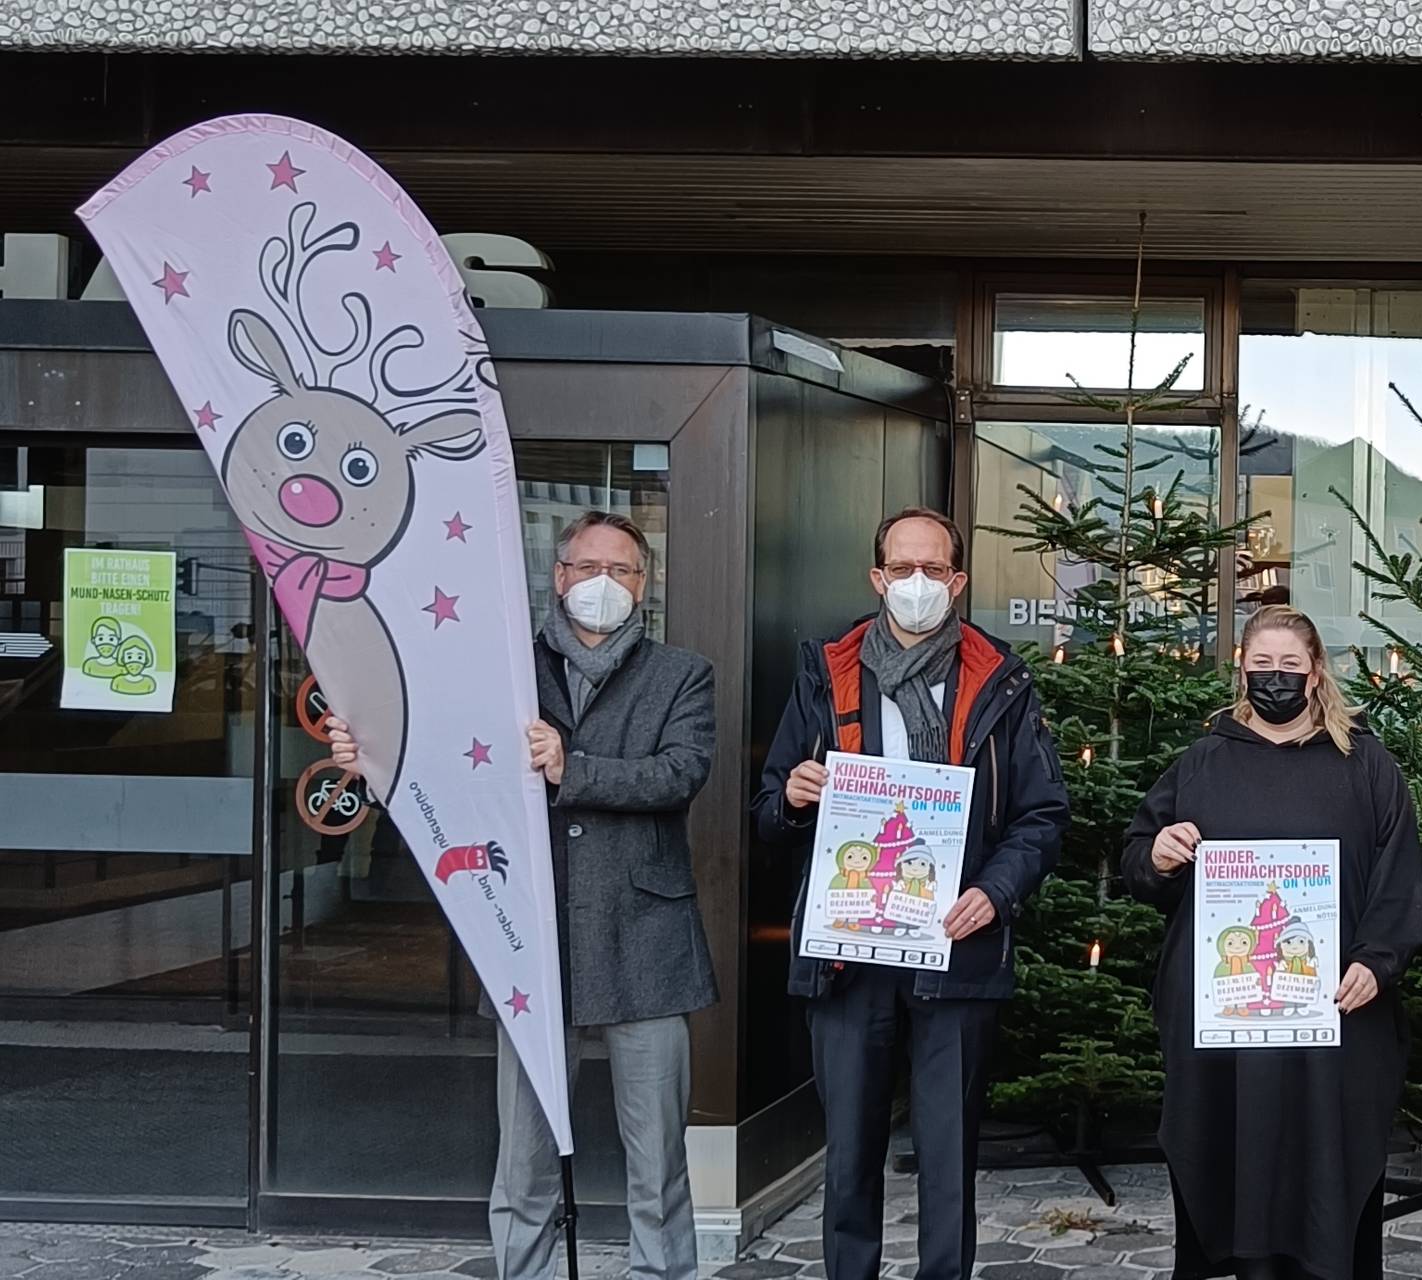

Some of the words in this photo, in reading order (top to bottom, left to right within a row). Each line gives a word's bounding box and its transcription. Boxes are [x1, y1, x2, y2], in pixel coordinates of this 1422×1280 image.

[70, 587, 170, 602] MUND-NASEN-SCHUTZ
[834, 762, 892, 781] KINDER-
[833, 777, 962, 803] WEIHNACHTSDORF
[911, 801, 927, 811] ON
[932, 802, 961, 813] TOUR
[918, 829, 964, 837] ANMELDUNG
[1205, 850, 1260, 864] KINDER-
[1205, 864, 1329, 879] WEIHNACHTSDORF
[1283, 878, 1298, 889] ON
[1303, 875, 1331, 887] TOUR
[830, 899, 870, 907] DEZEMBER
[891, 903, 930, 917] DEZEMBER
[1293, 903, 1337, 914] ANMELDUNG
[1217, 985, 1256, 995] DEZEMBER
[1276, 985, 1315, 994] DEZEMBER
